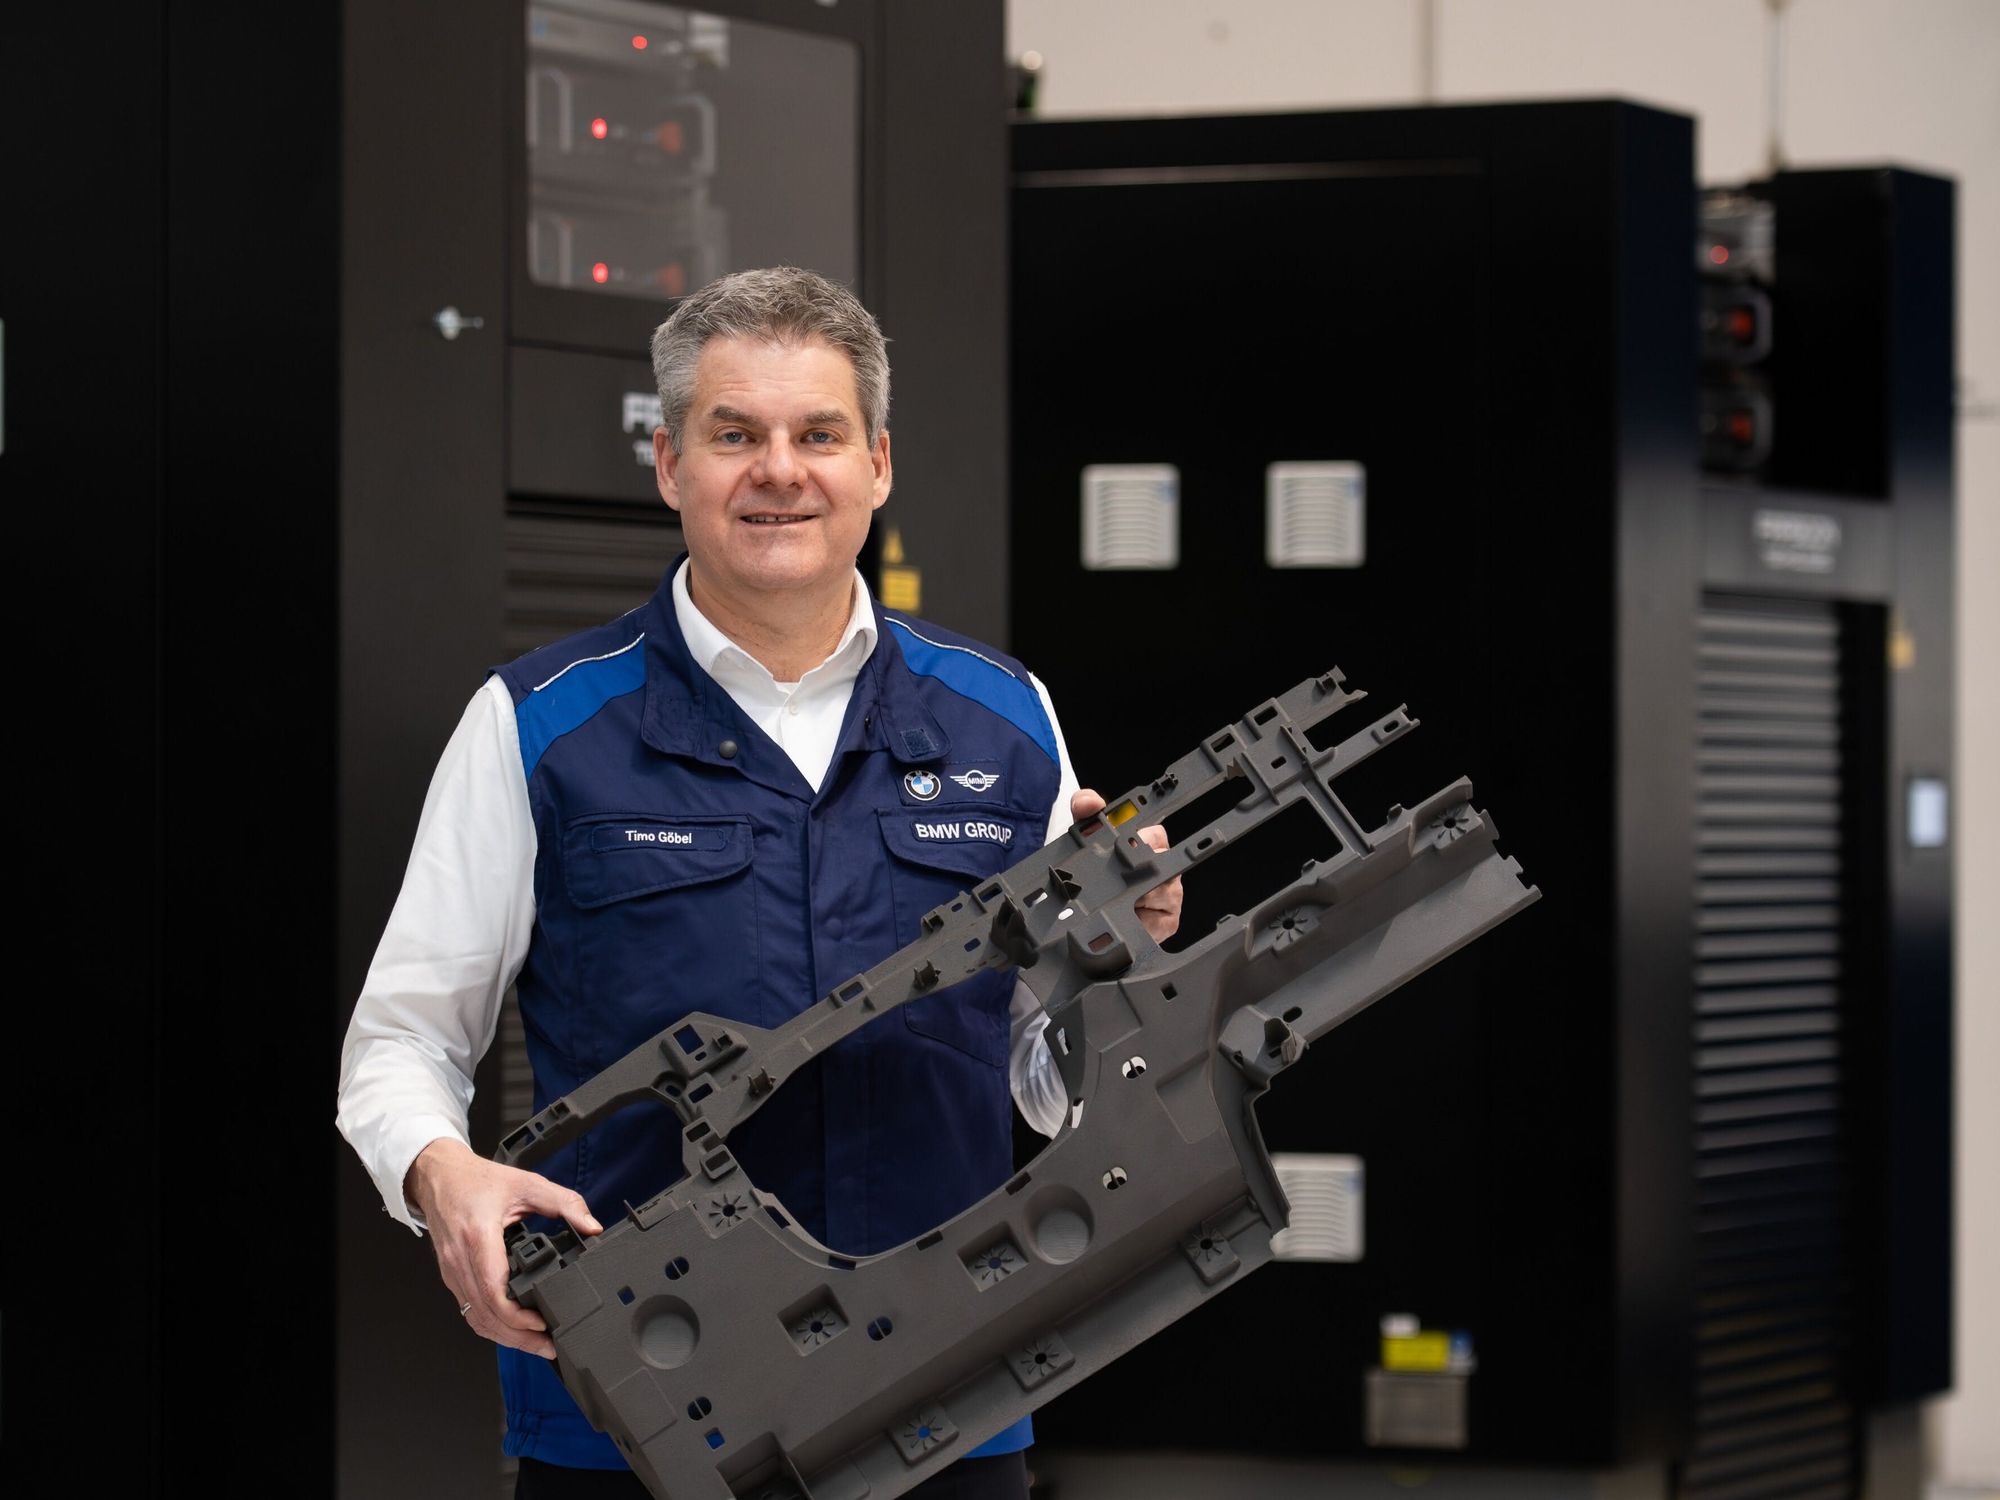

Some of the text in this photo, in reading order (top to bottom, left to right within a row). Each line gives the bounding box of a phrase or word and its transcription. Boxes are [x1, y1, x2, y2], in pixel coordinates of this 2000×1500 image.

[968, 777, 985, 785] MINI
[625, 830, 692, 844] Timo Göbel
[915, 822, 1012, 844] BMW GROUP
